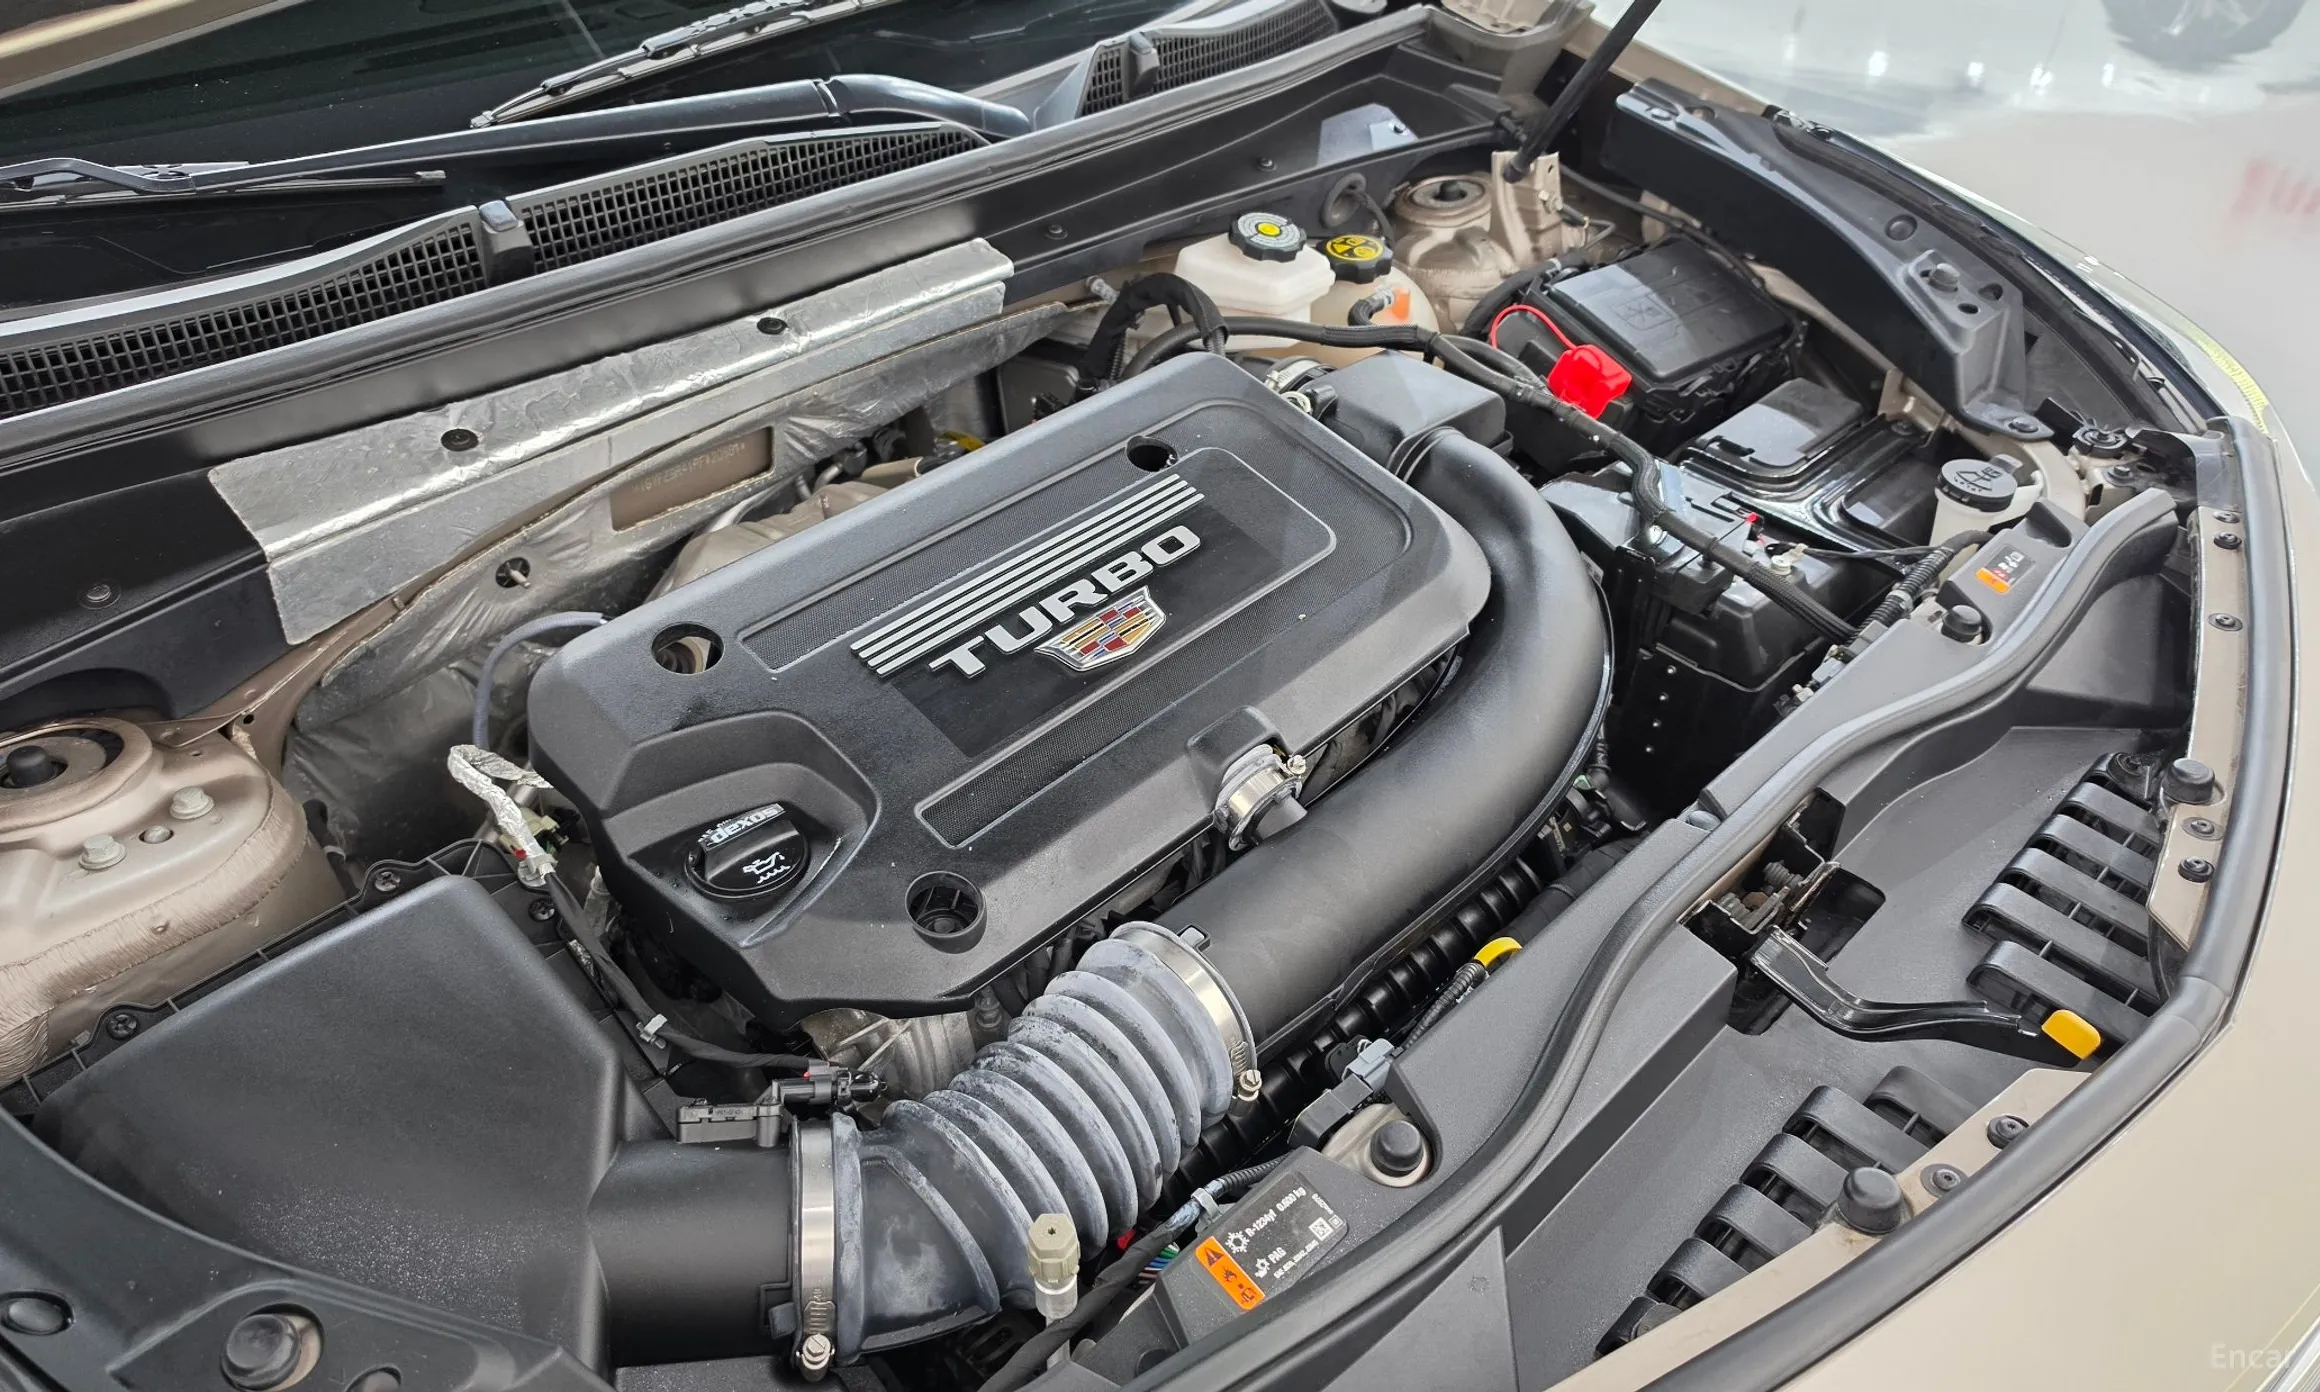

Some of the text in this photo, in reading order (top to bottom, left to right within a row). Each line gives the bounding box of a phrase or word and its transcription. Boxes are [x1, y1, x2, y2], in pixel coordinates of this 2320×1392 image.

[928, 525, 1202, 679] TURBO
[709, 807, 778, 844] dexos
[1268, 1247, 1287, 1264] PAG
